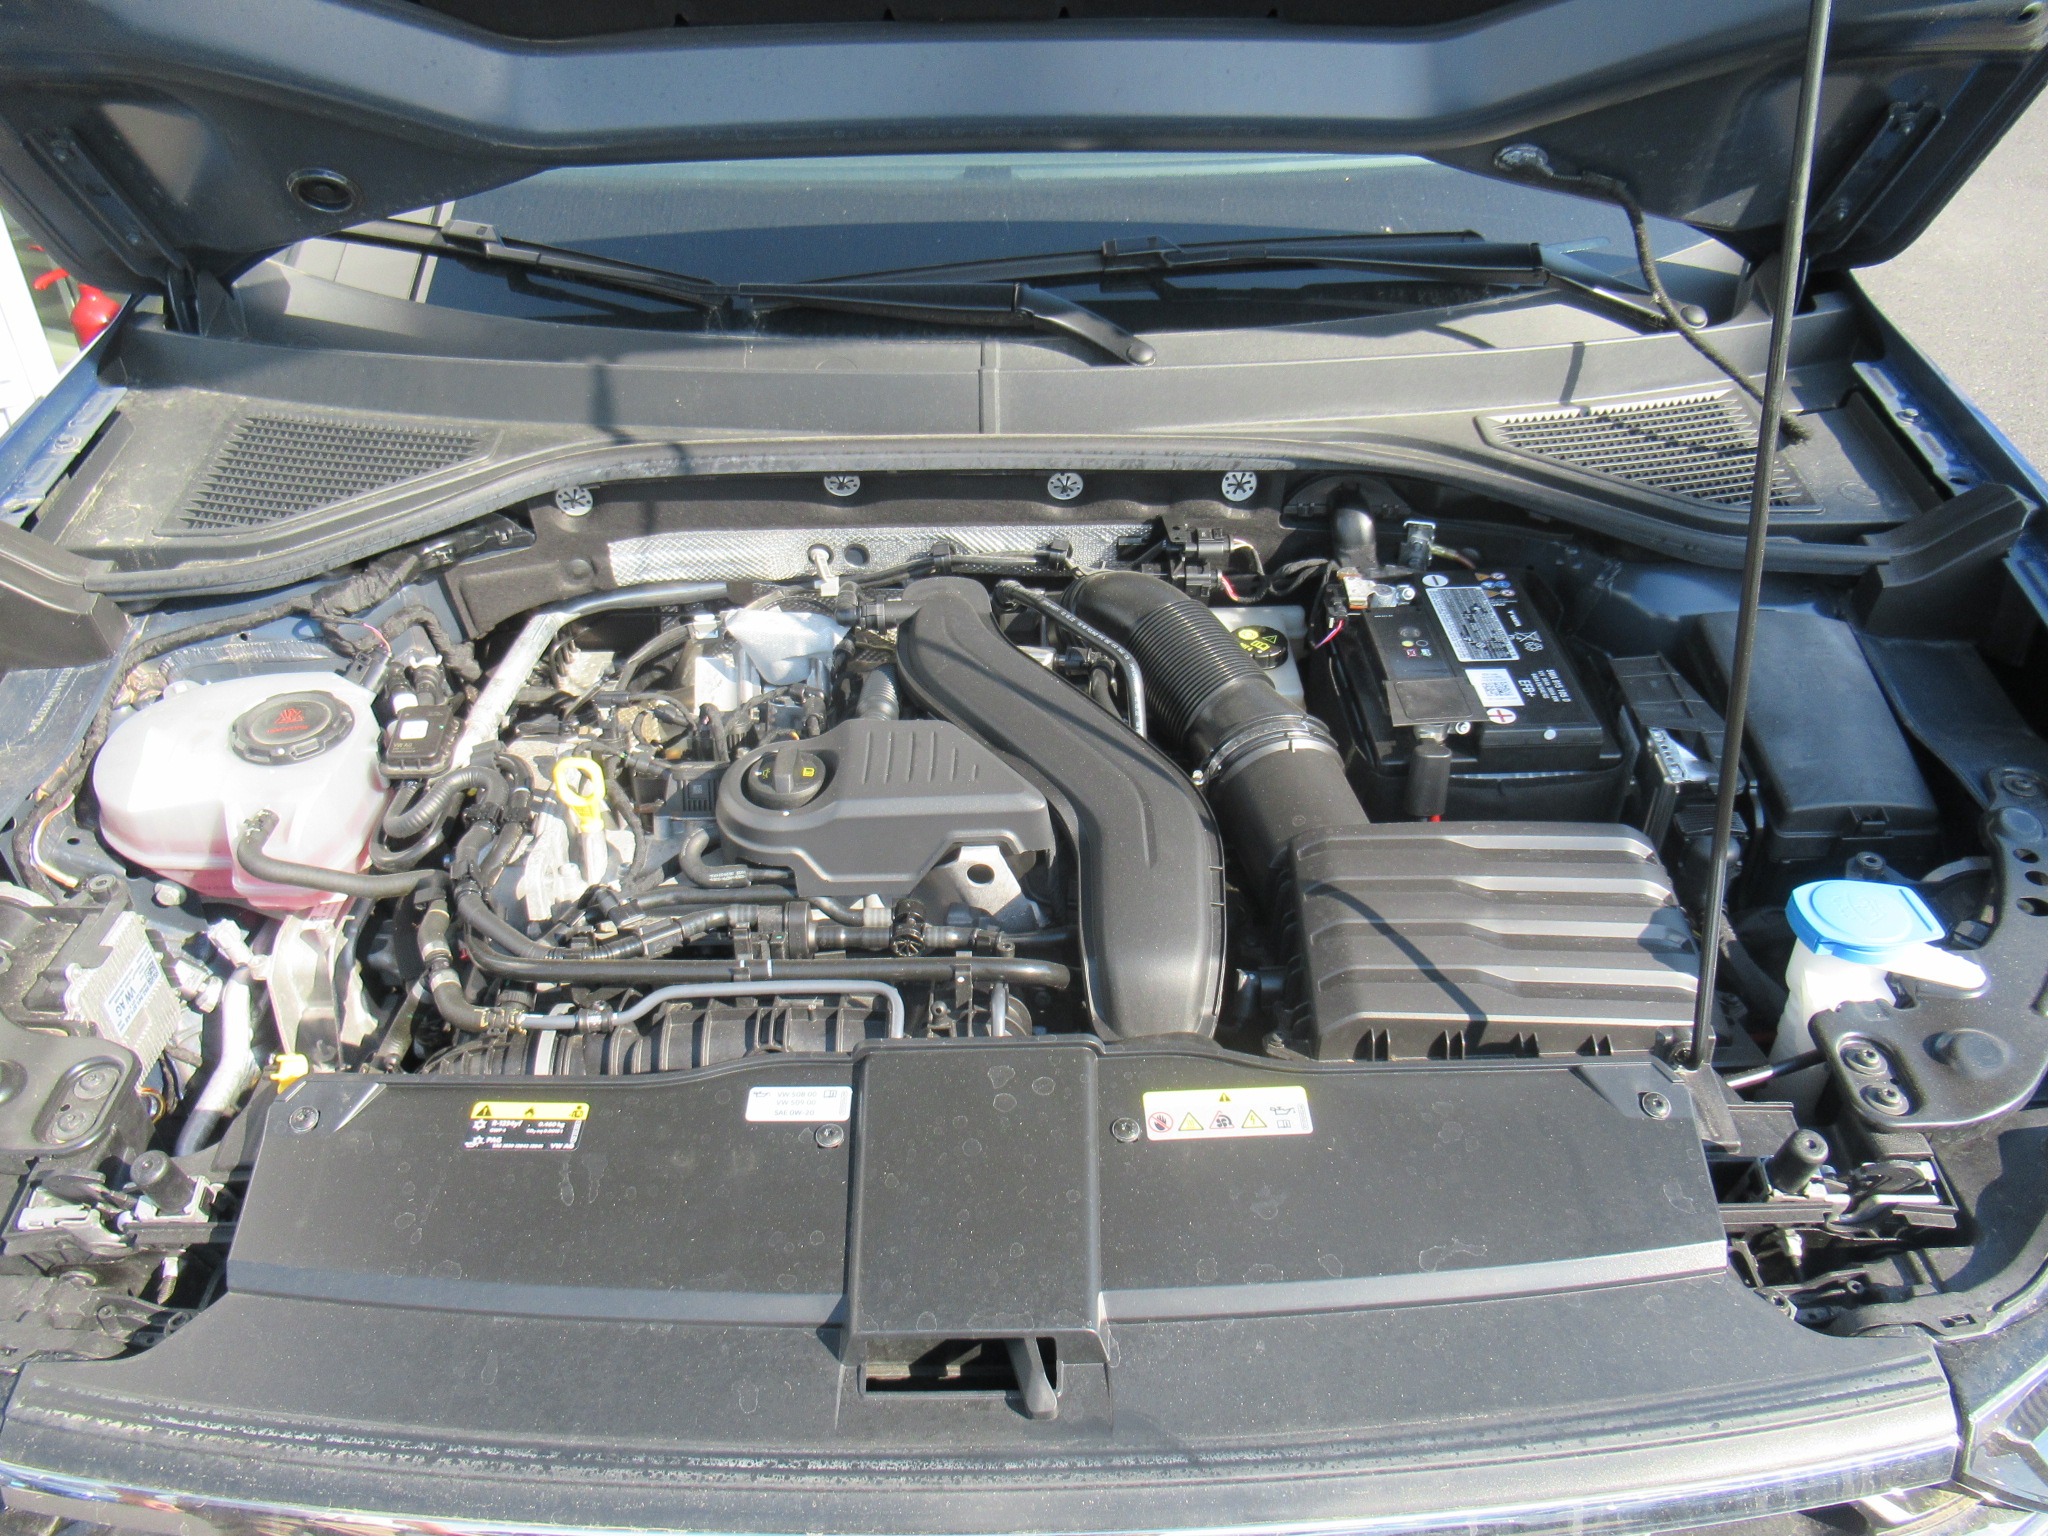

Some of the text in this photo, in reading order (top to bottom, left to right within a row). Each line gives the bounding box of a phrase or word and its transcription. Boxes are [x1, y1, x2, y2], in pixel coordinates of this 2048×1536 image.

[1518, 680, 1536, 697] EFB+
[124, 986, 136, 1004] VW
[115, 998, 126, 1017] AG
[486, 1136, 503, 1144] PAG
